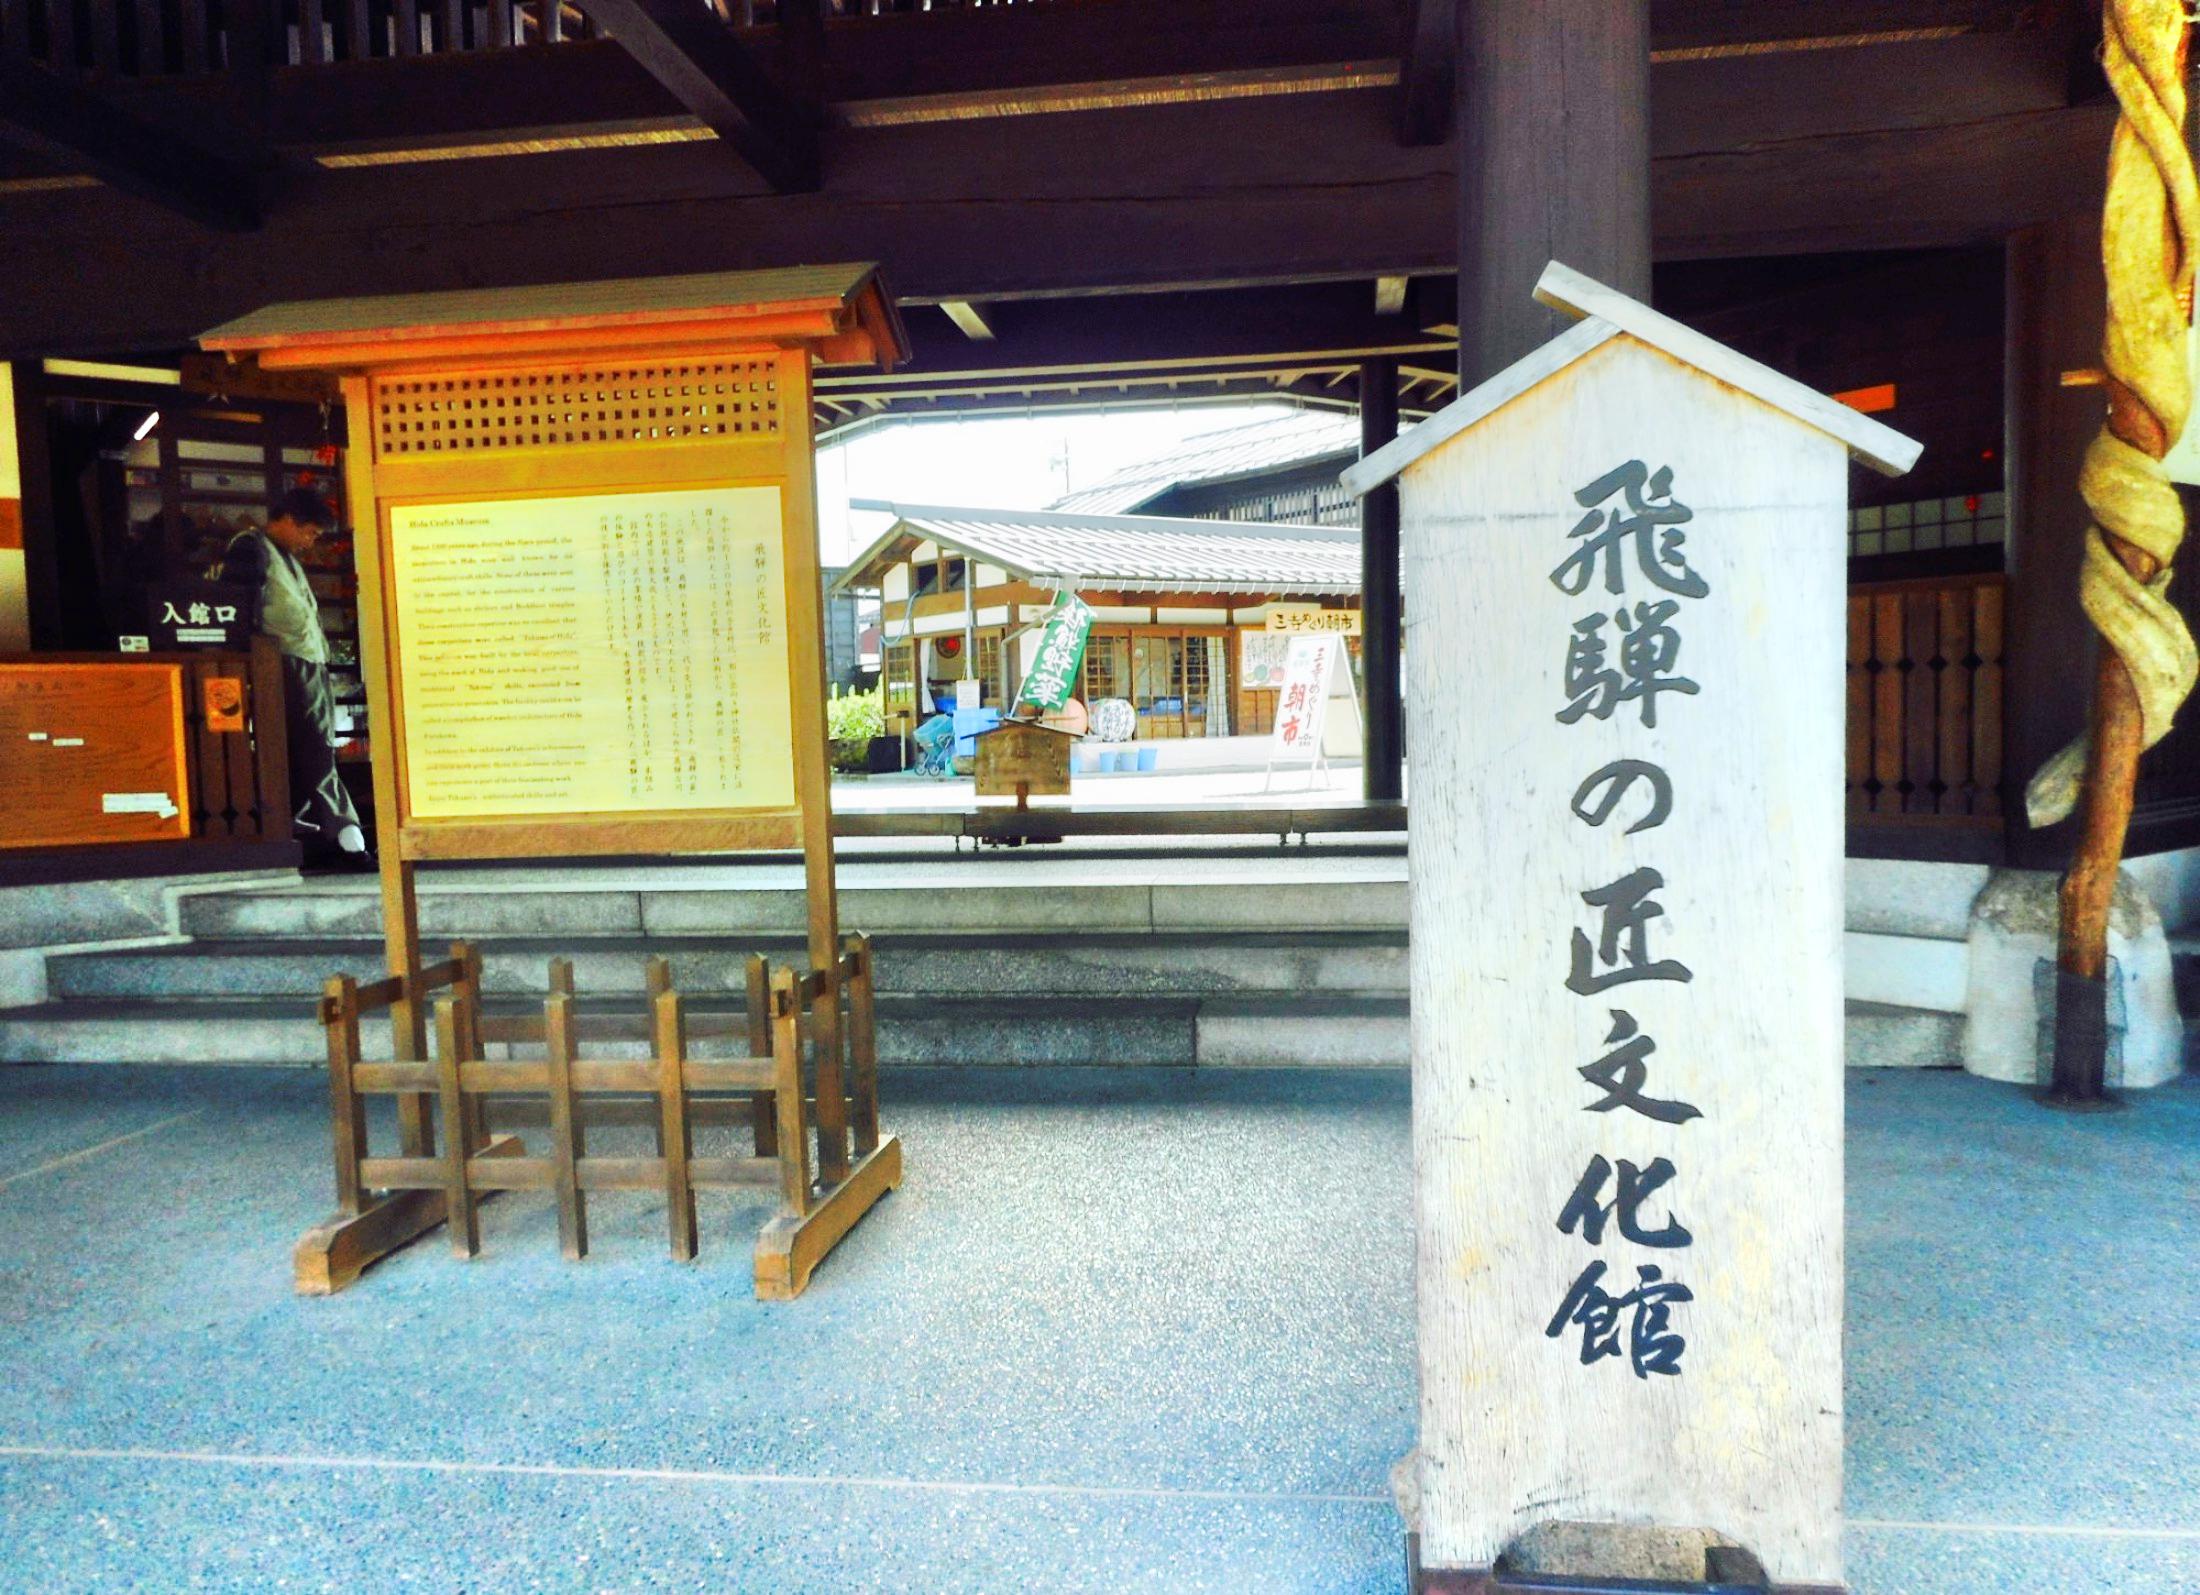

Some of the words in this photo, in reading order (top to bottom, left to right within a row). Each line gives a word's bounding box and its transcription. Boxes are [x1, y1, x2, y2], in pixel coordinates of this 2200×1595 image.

[161, 601, 237, 625] 入館口
[1281, 682, 1306, 746] 朝市
[1549, 459, 1711, 1380] 飛騨の匠文化館
